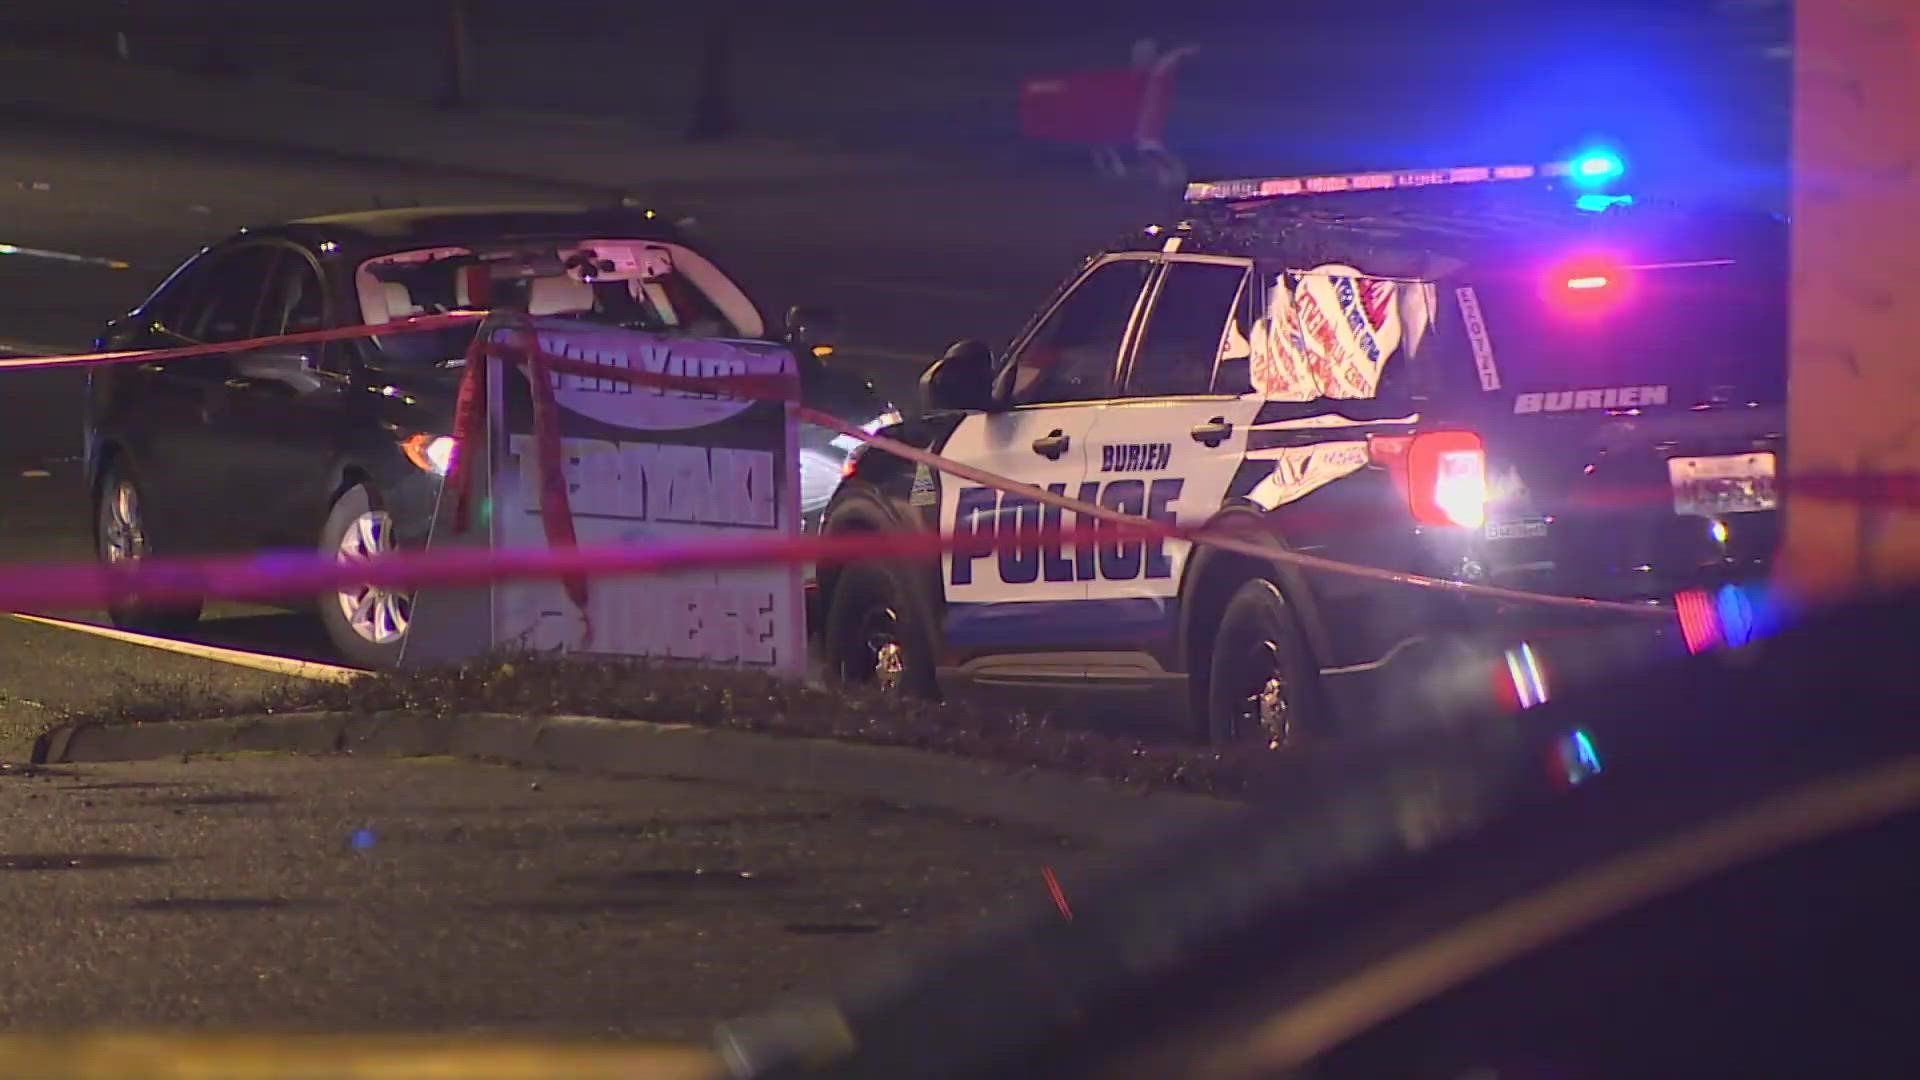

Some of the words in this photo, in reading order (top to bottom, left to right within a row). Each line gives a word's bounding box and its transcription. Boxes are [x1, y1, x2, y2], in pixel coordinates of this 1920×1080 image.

[1513, 385, 1668, 414] BURIEN
[1101, 443, 1172, 472] BURIEN
[951, 478, 1185, 586] POLICE
